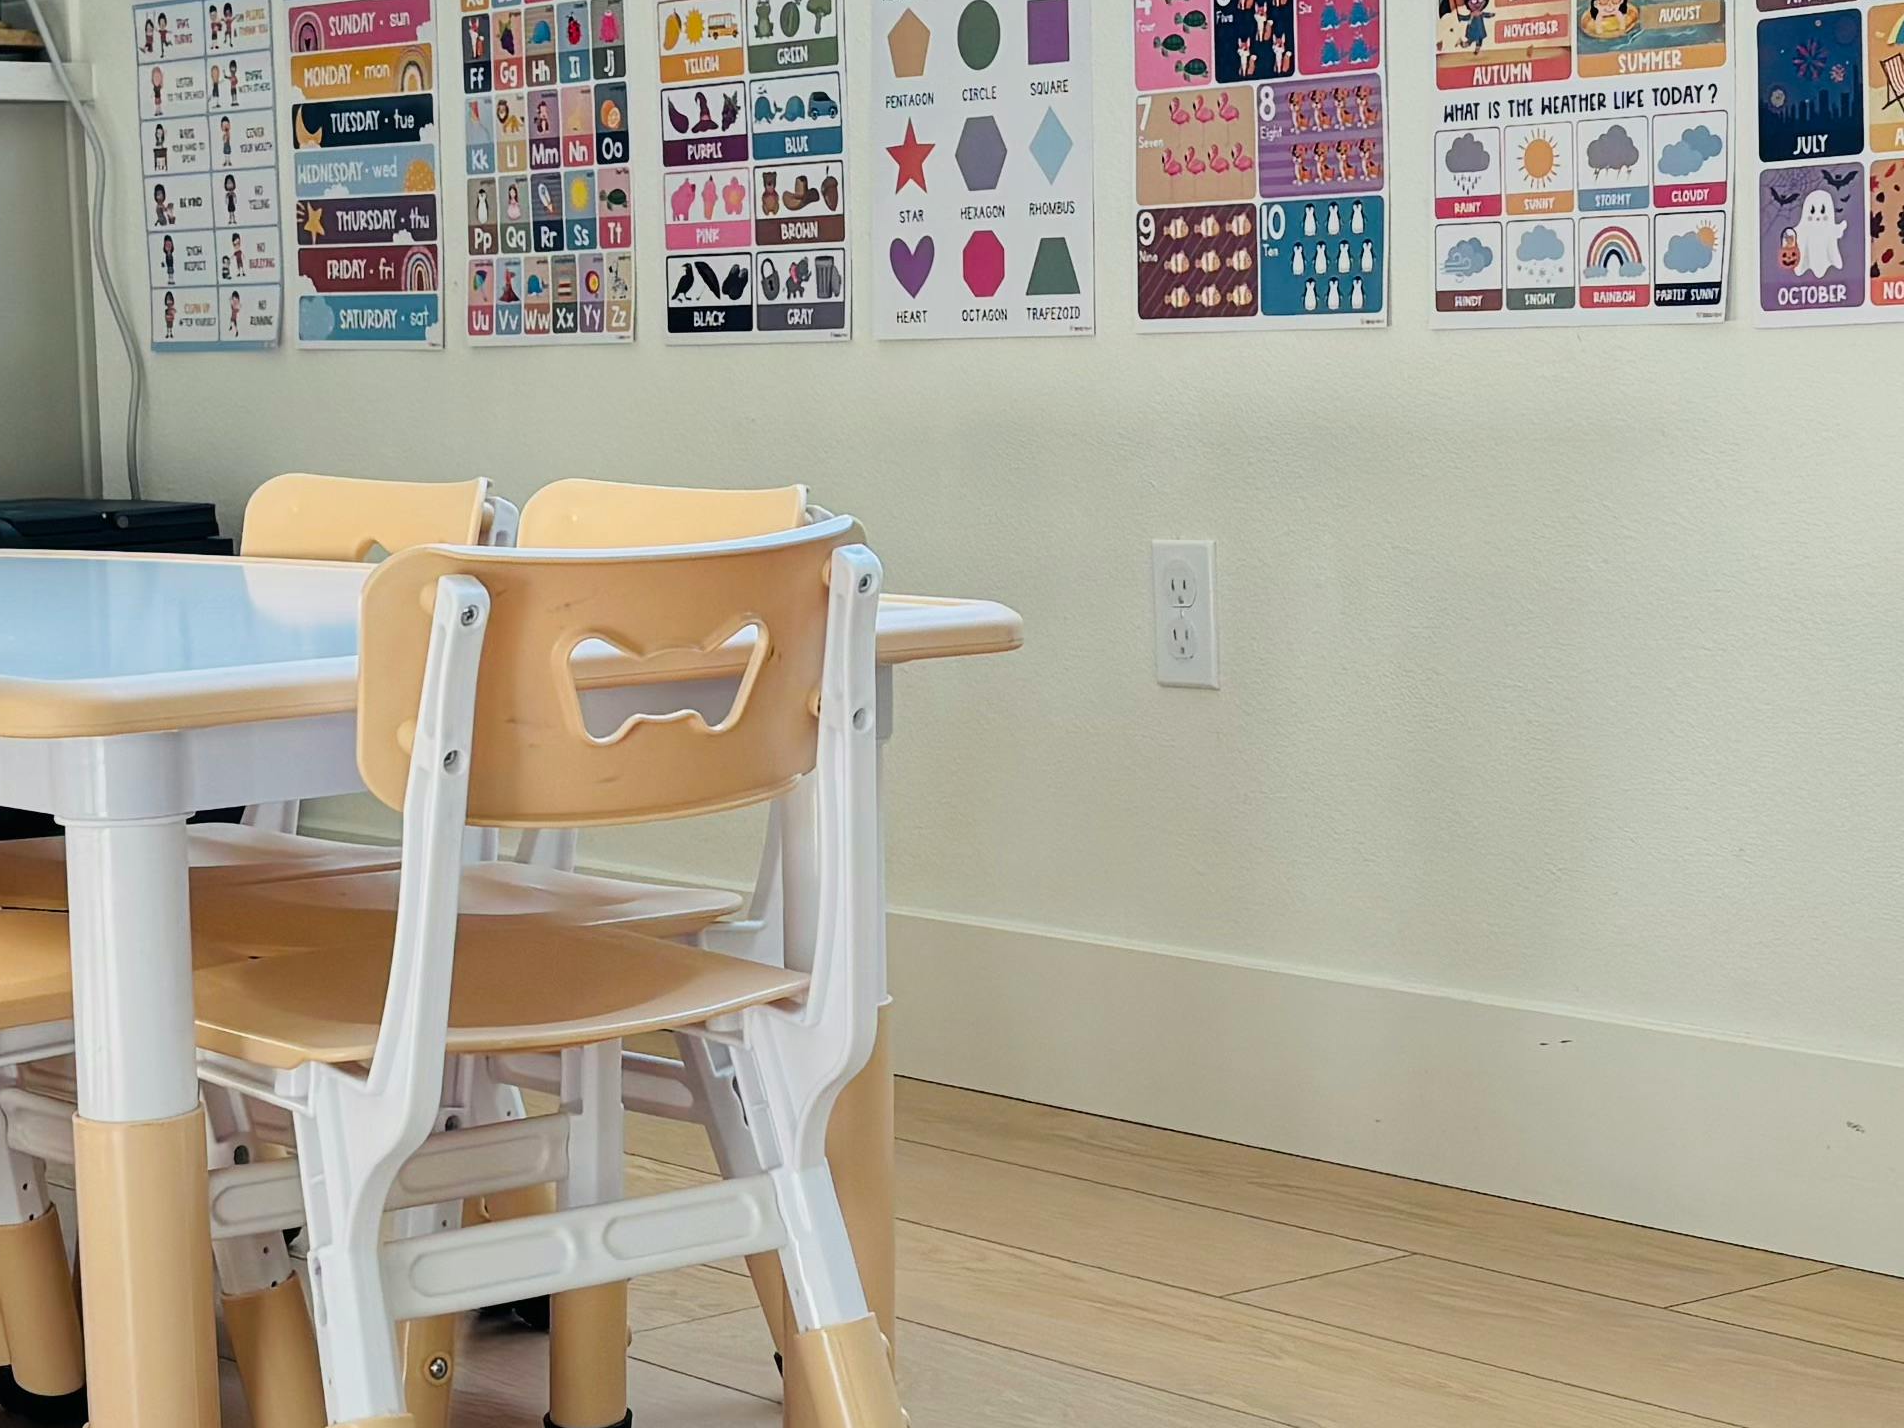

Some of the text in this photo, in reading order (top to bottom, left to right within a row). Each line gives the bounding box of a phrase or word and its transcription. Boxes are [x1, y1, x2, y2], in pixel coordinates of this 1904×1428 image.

[329, 11, 376, 37] SUNDAY
[1658, 4, 1702, 22] AUGUST
[1503, 20, 1560, 38] NOVEMBER
[1617, 48, 1682, 74] SUMMER
[304, 63, 352, 87] MONDAY
[1472, 62, 1534, 86] AUTUMN
[962, 85, 997, 102] CIRCLE
[1030, 79, 1069, 97] SQUARE
[885, 92, 935, 109] PENTAGON
[1443, 102, 1480, 124] WHAT
[1488, 100, 1500, 120] IS
[1508, 97, 1534, 118] THE
[1540, 90, 1608, 115] WEATHER
[1613, 89, 1645, 110] LIKE
[330, 110, 380, 133] TUESDAY
[1793, 134, 1829, 156] JULY
[297, 161, 363, 185] WEDNESDAY
[899, 209, 924, 224] STAR
[961, 205, 1006, 220] HEXAGON
[1029, 201, 1076, 217] RHOMBUS
[336, 209, 396, 232] THURSDAY
[327, 258, 367, 280] FRIDAY
[1777, 283, 1847, 306] OCTOBER
[339, 308, 398, 330] SATURDAY
[897, 309, 928, 324] HEART
[962, 308, 1008, 322] OCTAGON
[1026, 306, 1081, 321] TRAPEZOID
